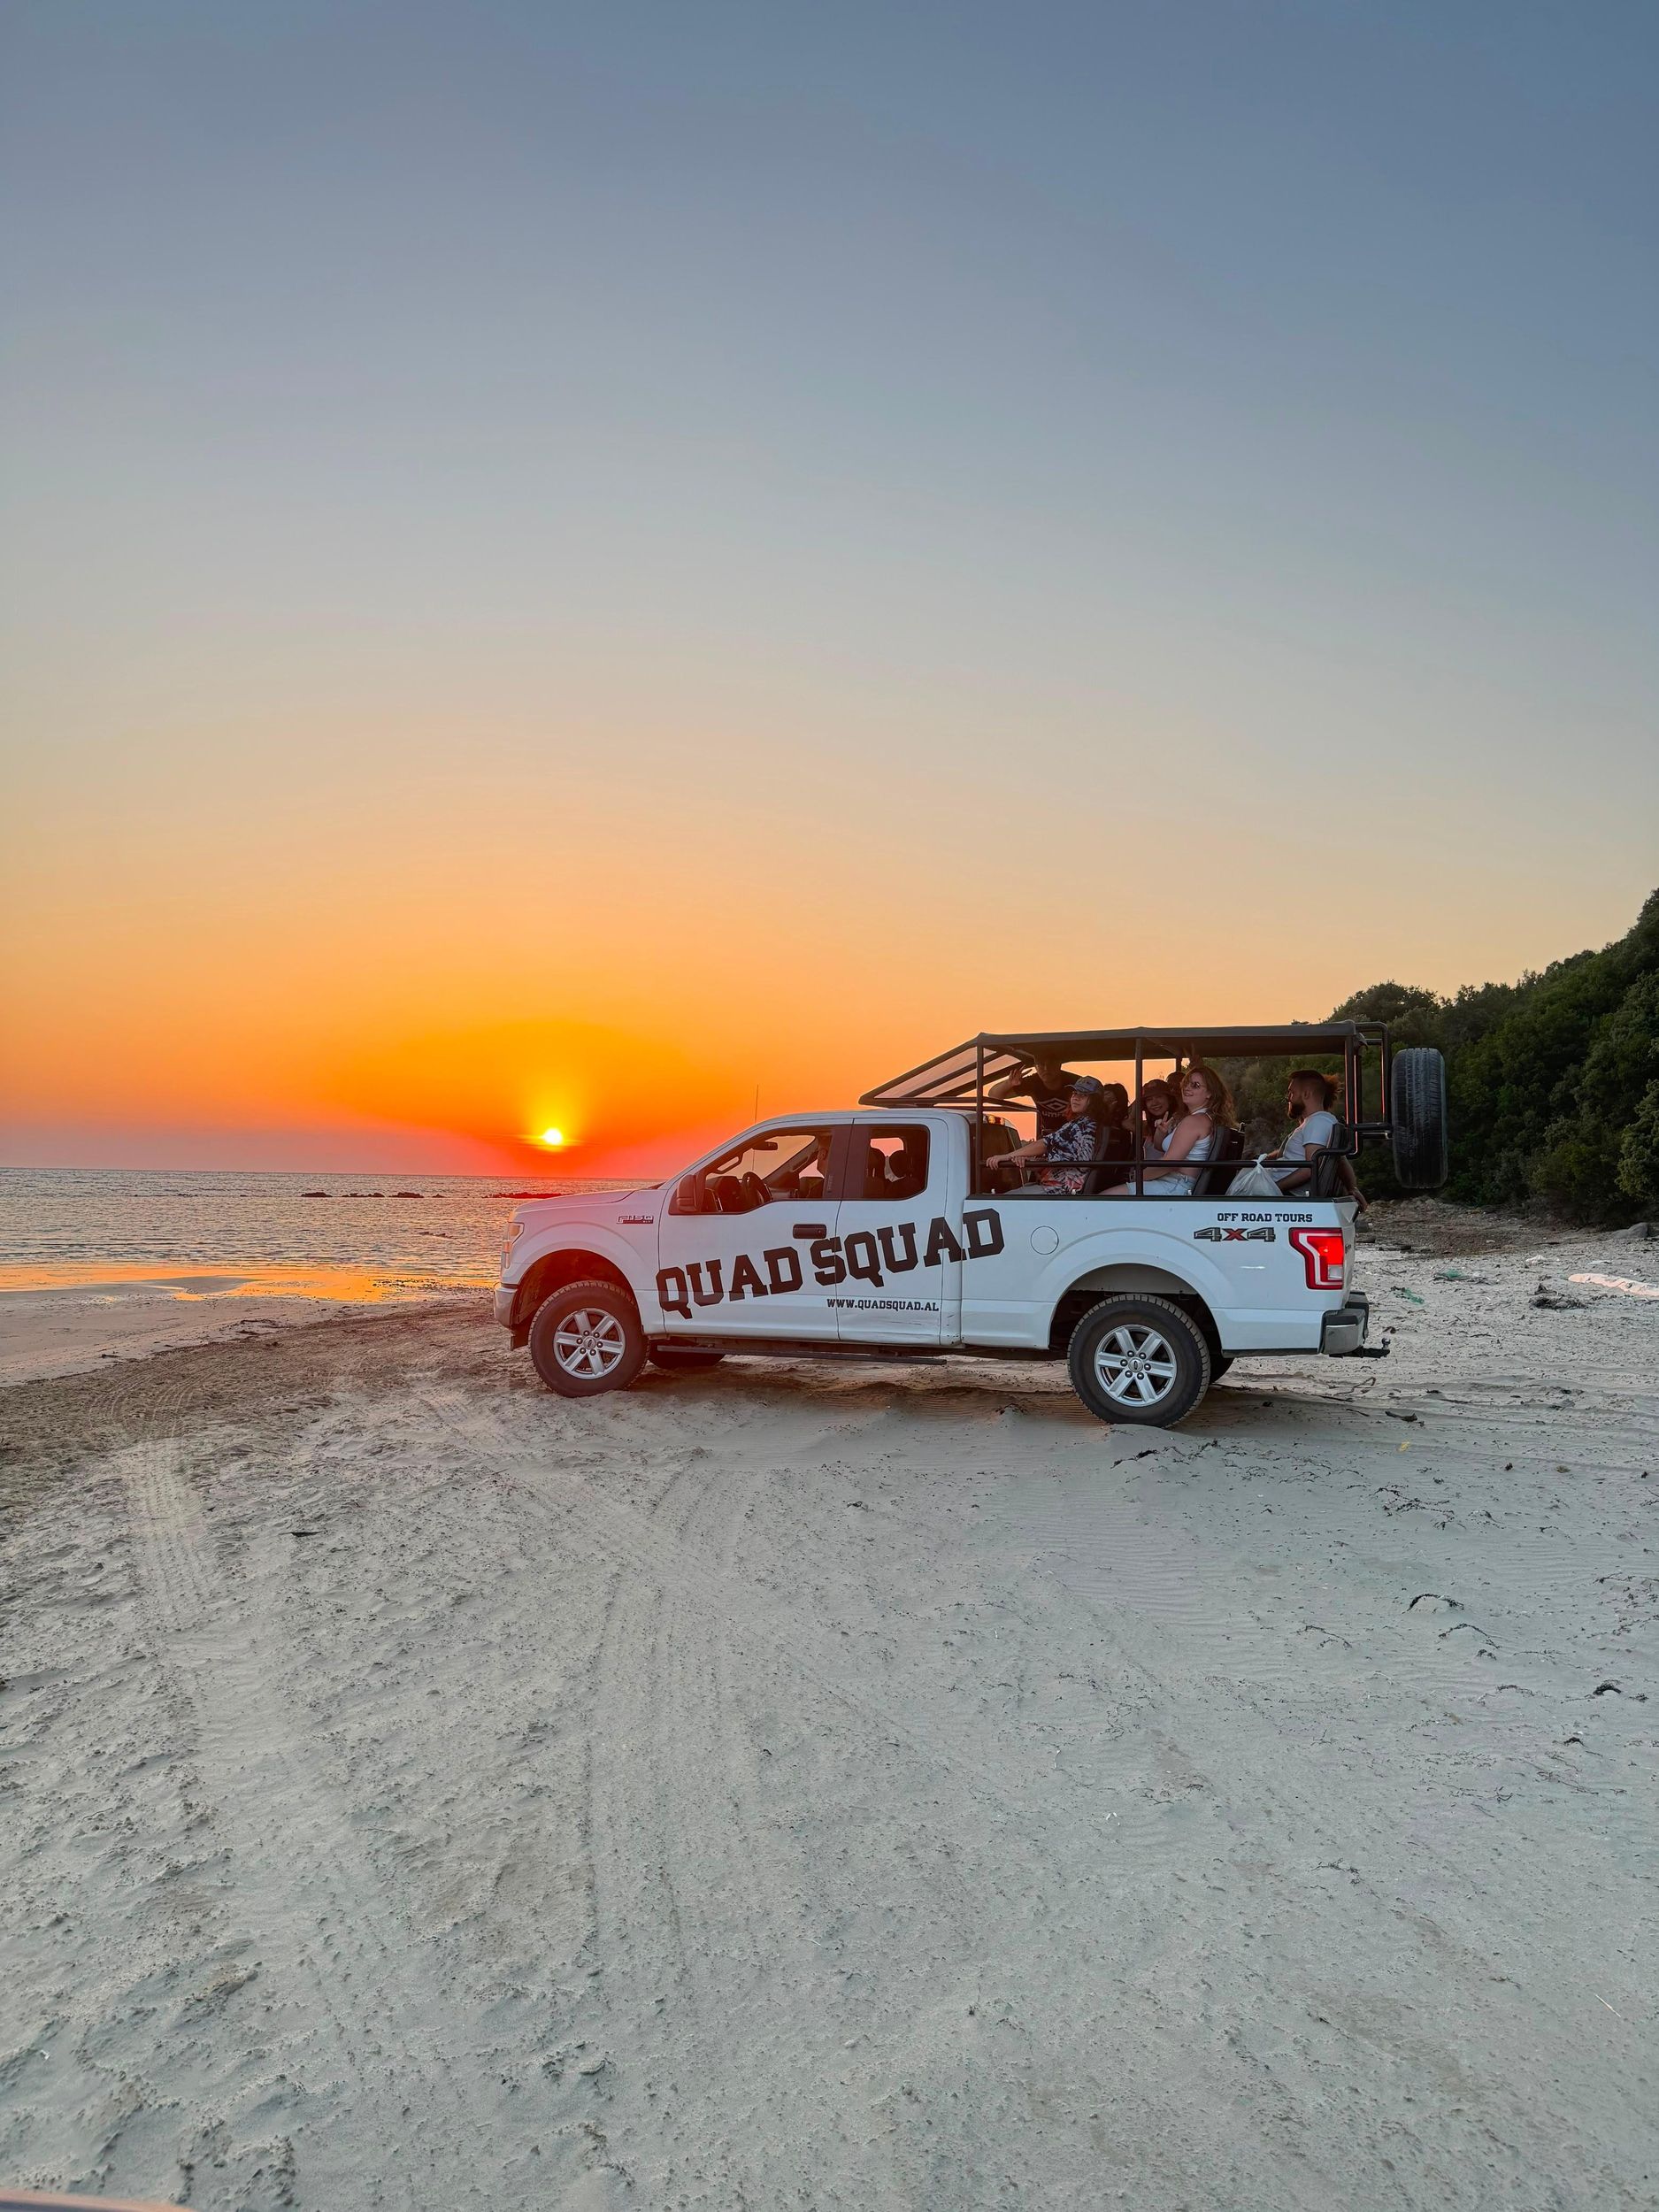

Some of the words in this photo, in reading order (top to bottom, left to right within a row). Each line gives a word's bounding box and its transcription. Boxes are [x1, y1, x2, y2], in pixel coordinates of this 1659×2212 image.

[1217, 1212, 1239, 1222] OFF
[1241, 1213, 1272, 1222] ROAD
[1275, 1213, 1313, 1222] TOURS
[656, 1246, 803, 1320] QUAD
[810, 1208, 1005, 1287] SQUAD
[826, 1298, 940, 1311] WWW.QUADSQUAD.AL
